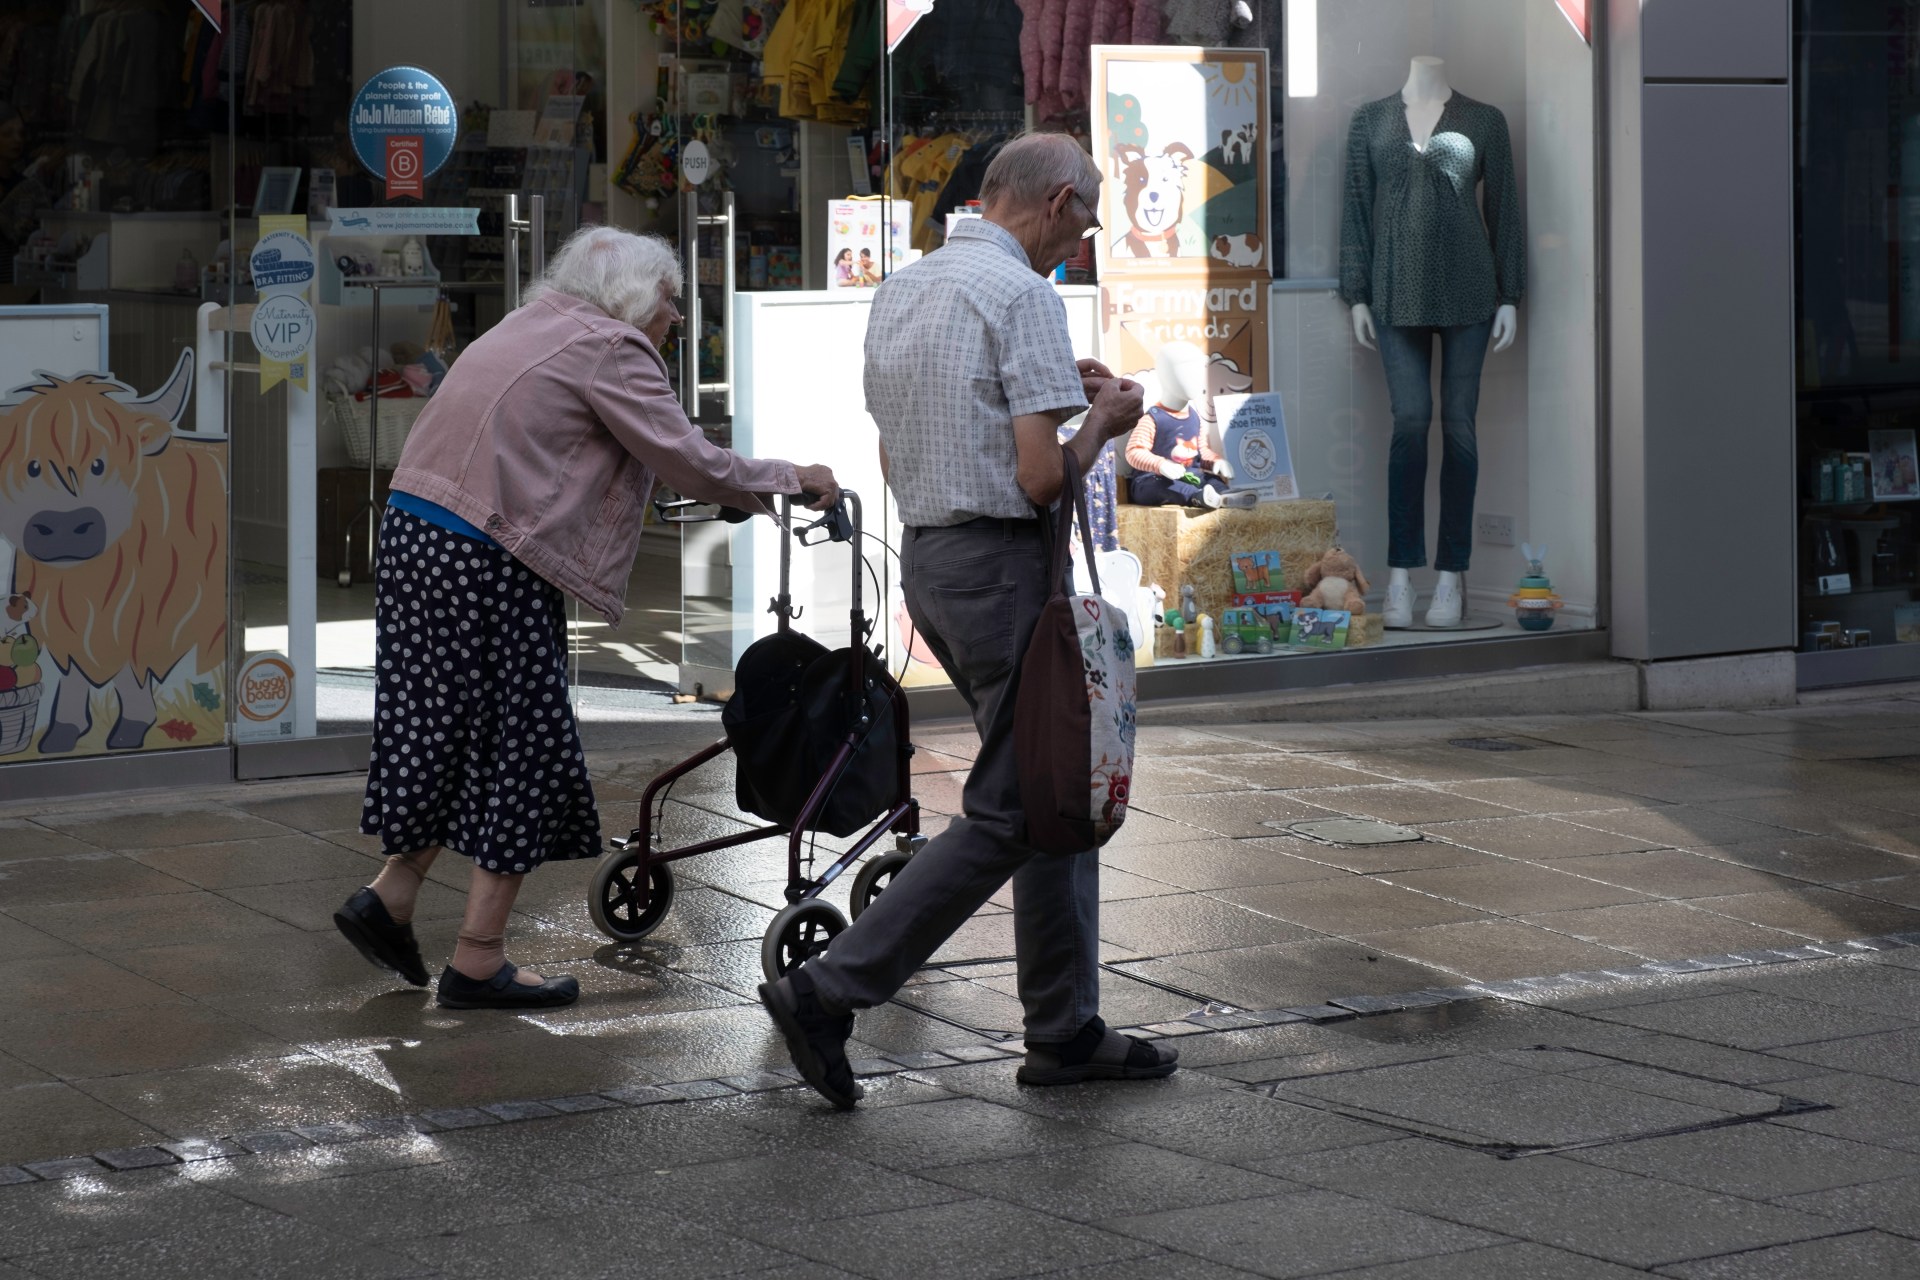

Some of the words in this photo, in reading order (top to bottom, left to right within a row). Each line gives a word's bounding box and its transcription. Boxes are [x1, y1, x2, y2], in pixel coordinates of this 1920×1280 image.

[378, 82, 406, 91] People
[415, 81, 429, 89] the
[365, 92, 391, 101] planet
[393, 92, 419, 100] above
[420, 92, 442, 101] profit
[356, 104, 381, 124] JoJo
[384, 104, 422, 124] Maman
[424, 104, 450, 124] Bébé
[436, 127, 451, 135] good
[390, 140, 418, 148] Certified
[398, 156, 411, 172] B
[684, 157, 707, 169] PUSH
[262, 231, 290, 244] MATERNITY
[256, 276, 274, 286] BRA
[277, 271, 309, 283] FITTING
[1116, 280, 1257, 318] Farmyard
[256, 306, 311, 325] Maternity
[263, 322, 301, 343] VIP
[1139, 315, 1231, 342] Friends
[262, 343, 305, 359] SHOPPING
[246, 675, 286, 692] buggy
[246, 686, 286, 704] board
